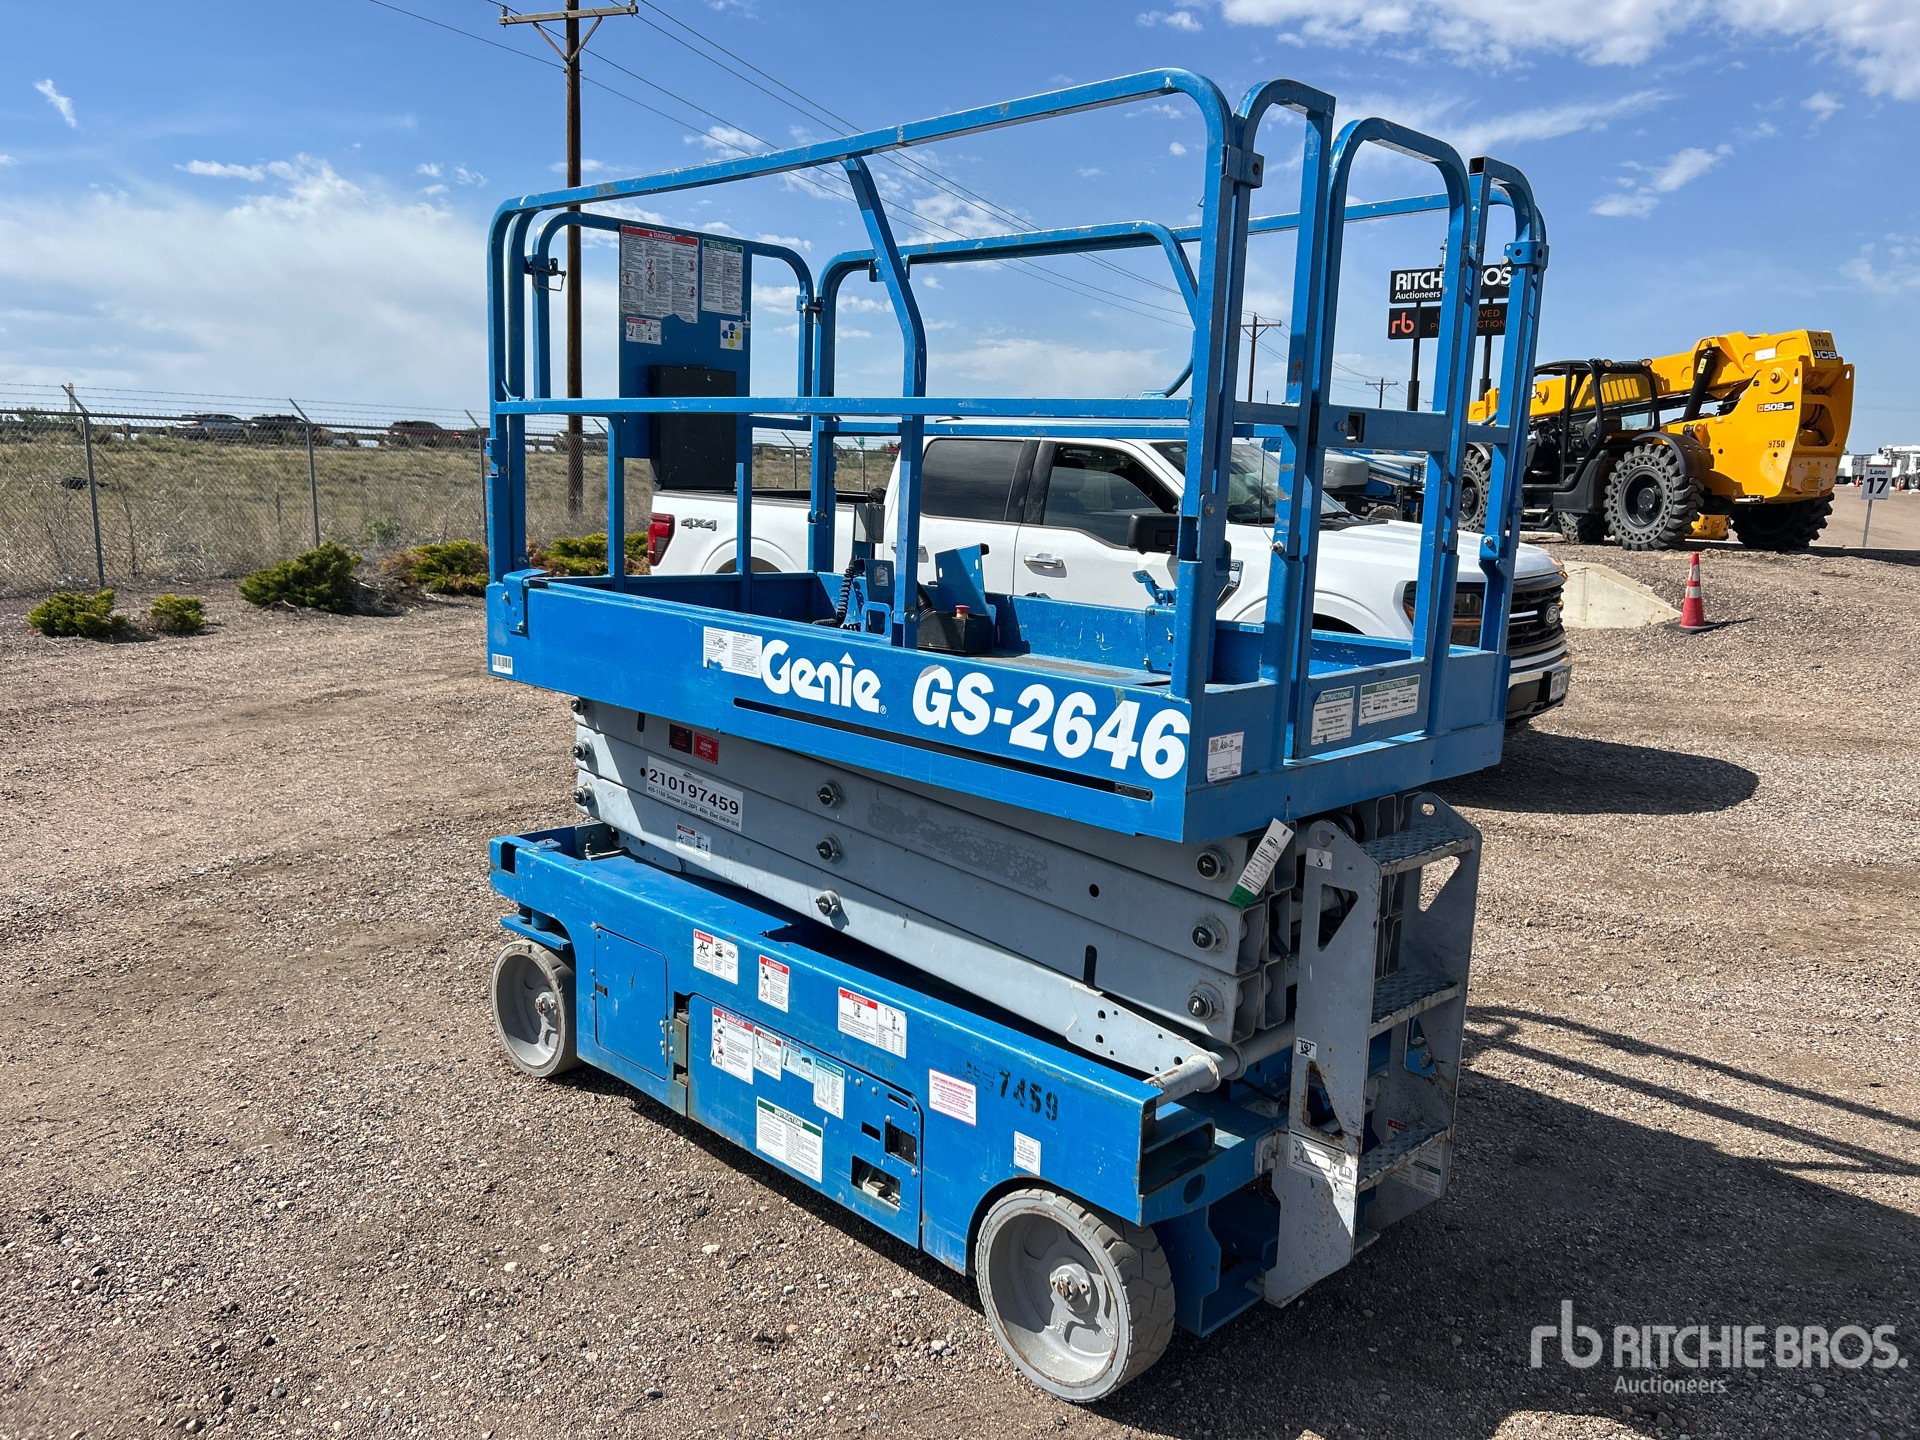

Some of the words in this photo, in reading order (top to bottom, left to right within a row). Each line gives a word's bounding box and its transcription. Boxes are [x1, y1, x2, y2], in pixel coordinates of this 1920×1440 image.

[653, 232, 676, 241] DANGER
[708, 242, 739, 252] INSTRUCTIONS
[1395, 271, 1443, 291] RITCH
[1395, 290, 1441, 300] Auctioneers
[1391, 312, 1415, 334] rb
[1813, 339, 1830, 347] 9750
[1814, 351, 1837, 359] JCB
[1768, 440, 1785, 448] 9750
[1866, 477, 1889, 494] 17
[761, 639, 880, 711] Genie
[1376, 679, 1408, 692] INSTRUCTIONS
[913, 664, 1190, 780] GS-2646
[649, 768, 739, 816] 210197459
[768, 960, 784, 971] DANGER
[852, 994, 869, 1006] DANGER
[726, 1013, 746, 1028] DANGER
[763, 1033, 777, 1044] DANGER
[816, 1058, 843, 1077] INSTRUCTIONS
